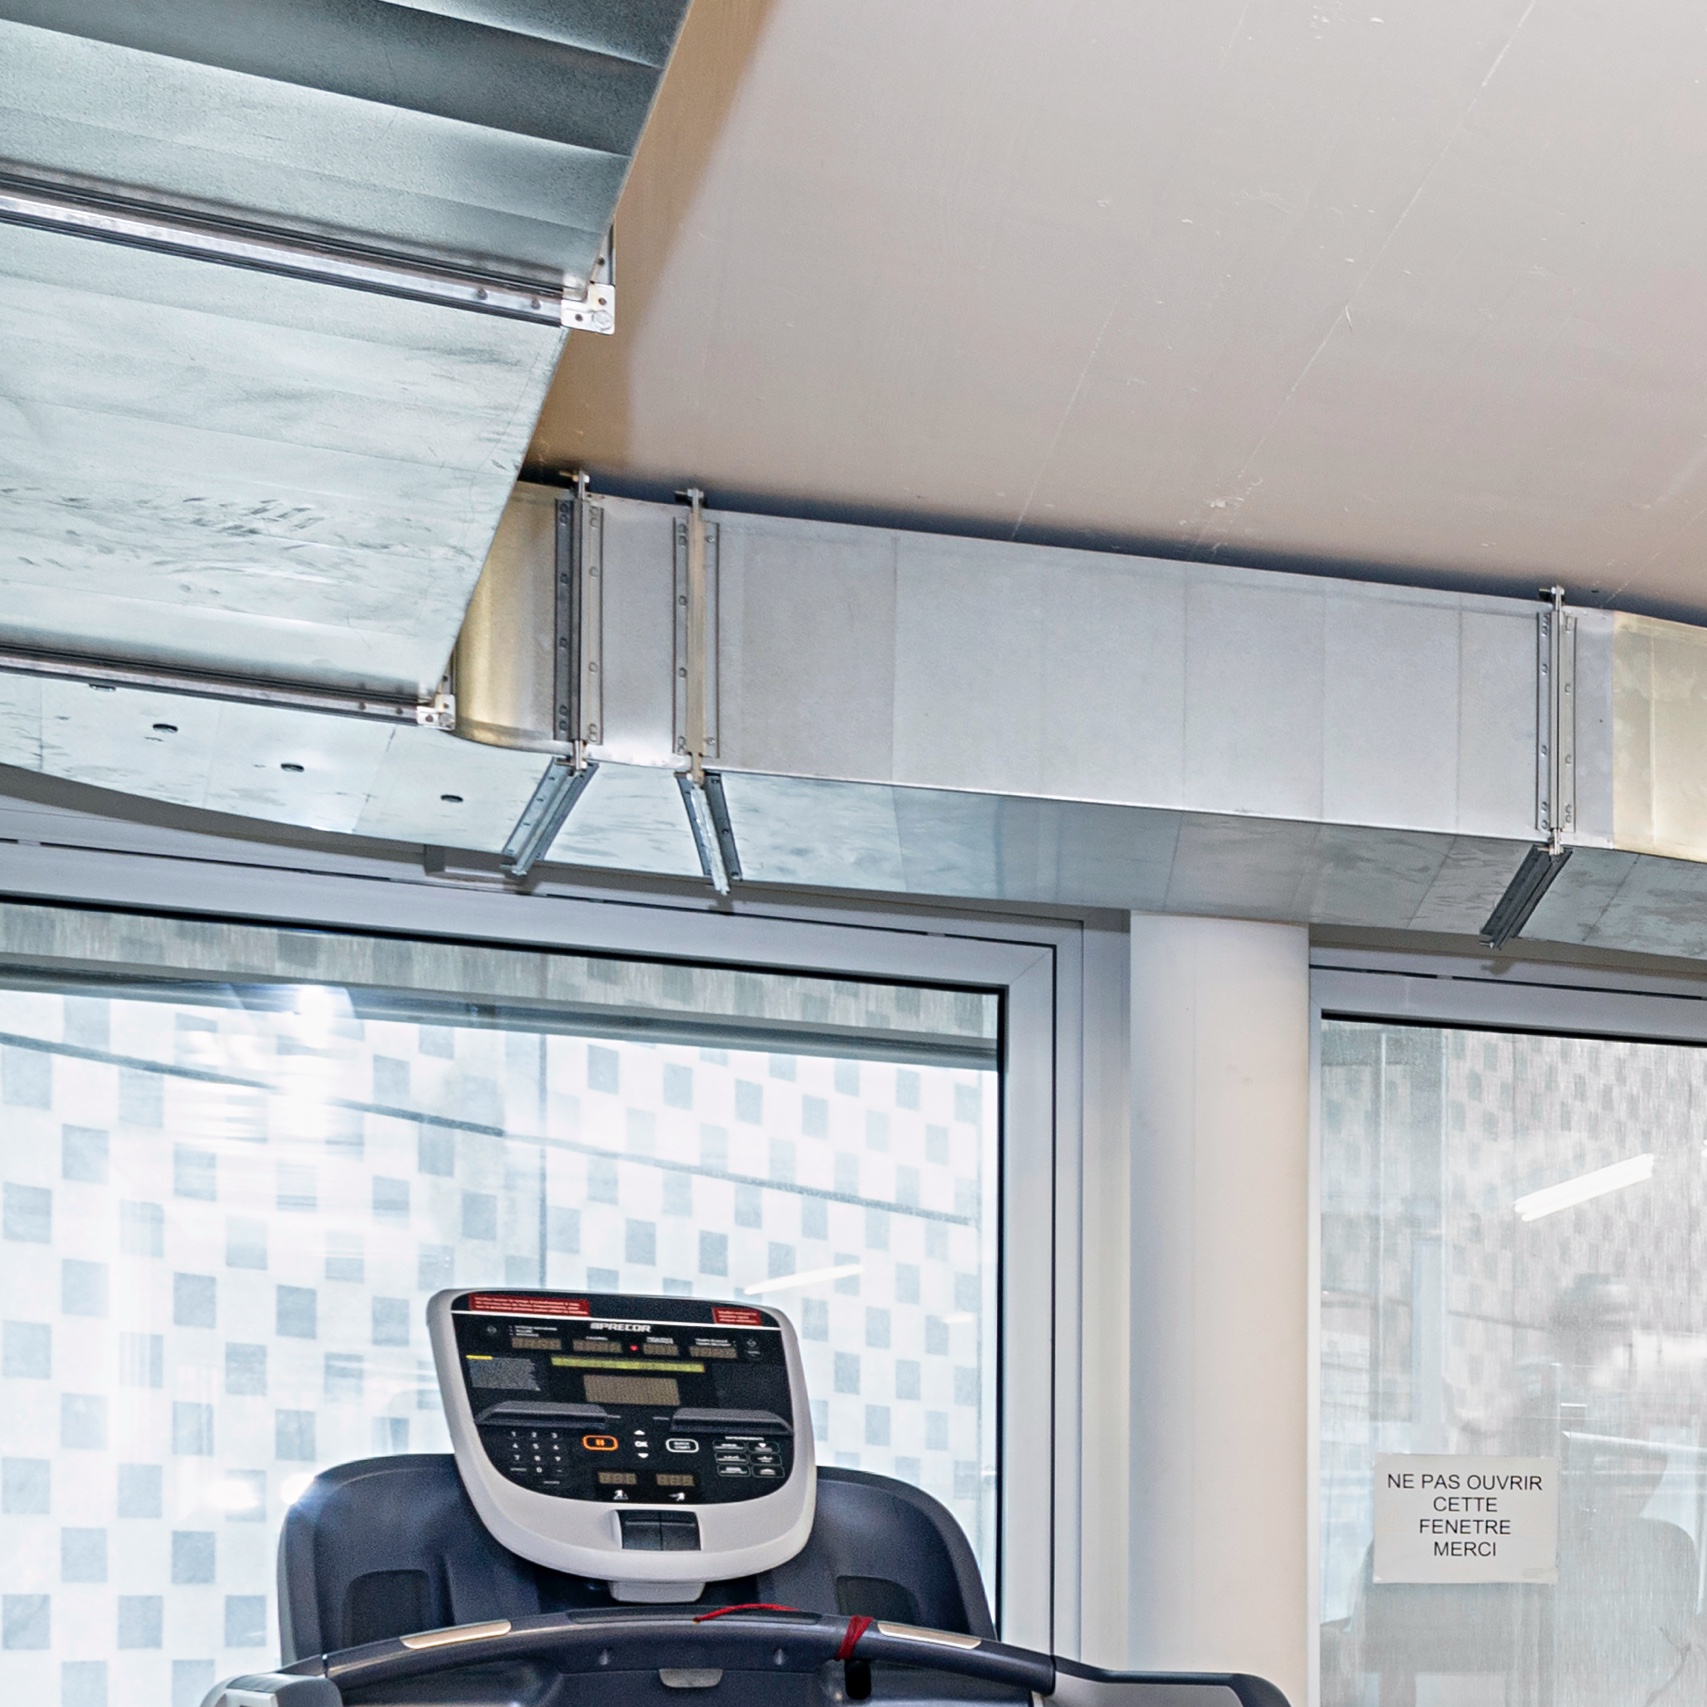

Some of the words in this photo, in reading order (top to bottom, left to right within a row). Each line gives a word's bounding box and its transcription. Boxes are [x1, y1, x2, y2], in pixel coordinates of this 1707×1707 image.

[598, 1323, 651, 1333] PRECOR
[1387, 1474, 1415, 1489] NE
[1421, 1474, 1461, 1490] PAS
[1466, 1475, 1543, 1491] OUVRIR
[1433, 1496, 1498, 1512] CETTE
[1419, 1519, 1511, 1535] FENETRE
[1433, 1541, 1497, 1557] MERCI
